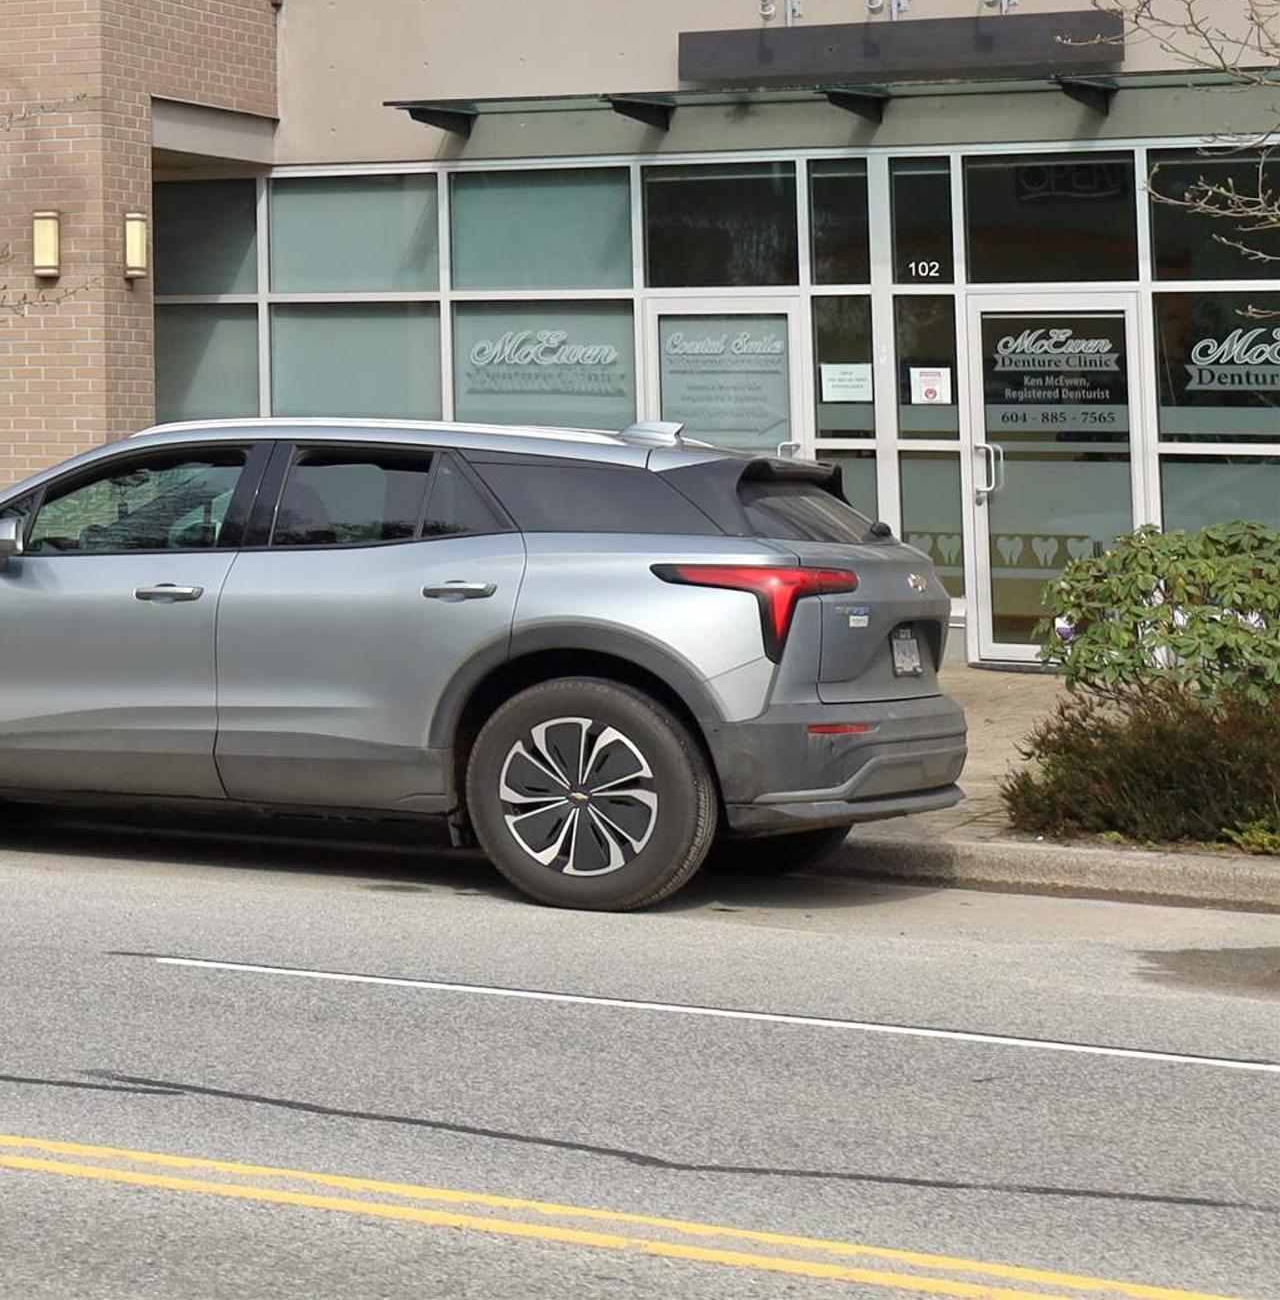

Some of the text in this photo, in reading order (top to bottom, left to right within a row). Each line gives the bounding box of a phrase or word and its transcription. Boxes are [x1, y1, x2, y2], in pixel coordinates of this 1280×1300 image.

[908, 261, 940, 277] 102
[470, 330, 619, 366] McEwen
[997, 328, 1113, 354] McEwen
[1001, 355, 1112, 369] Denture Clinic
[1023, 375, 1090, 388] Ken McEwen,
[1004, 387, 1111, 401] Registered Denturist
[1001, 411, 1028, 424] 604
[1041, 411, 1067, 424] 885
[1080, 411, 1117, 424] 7565
